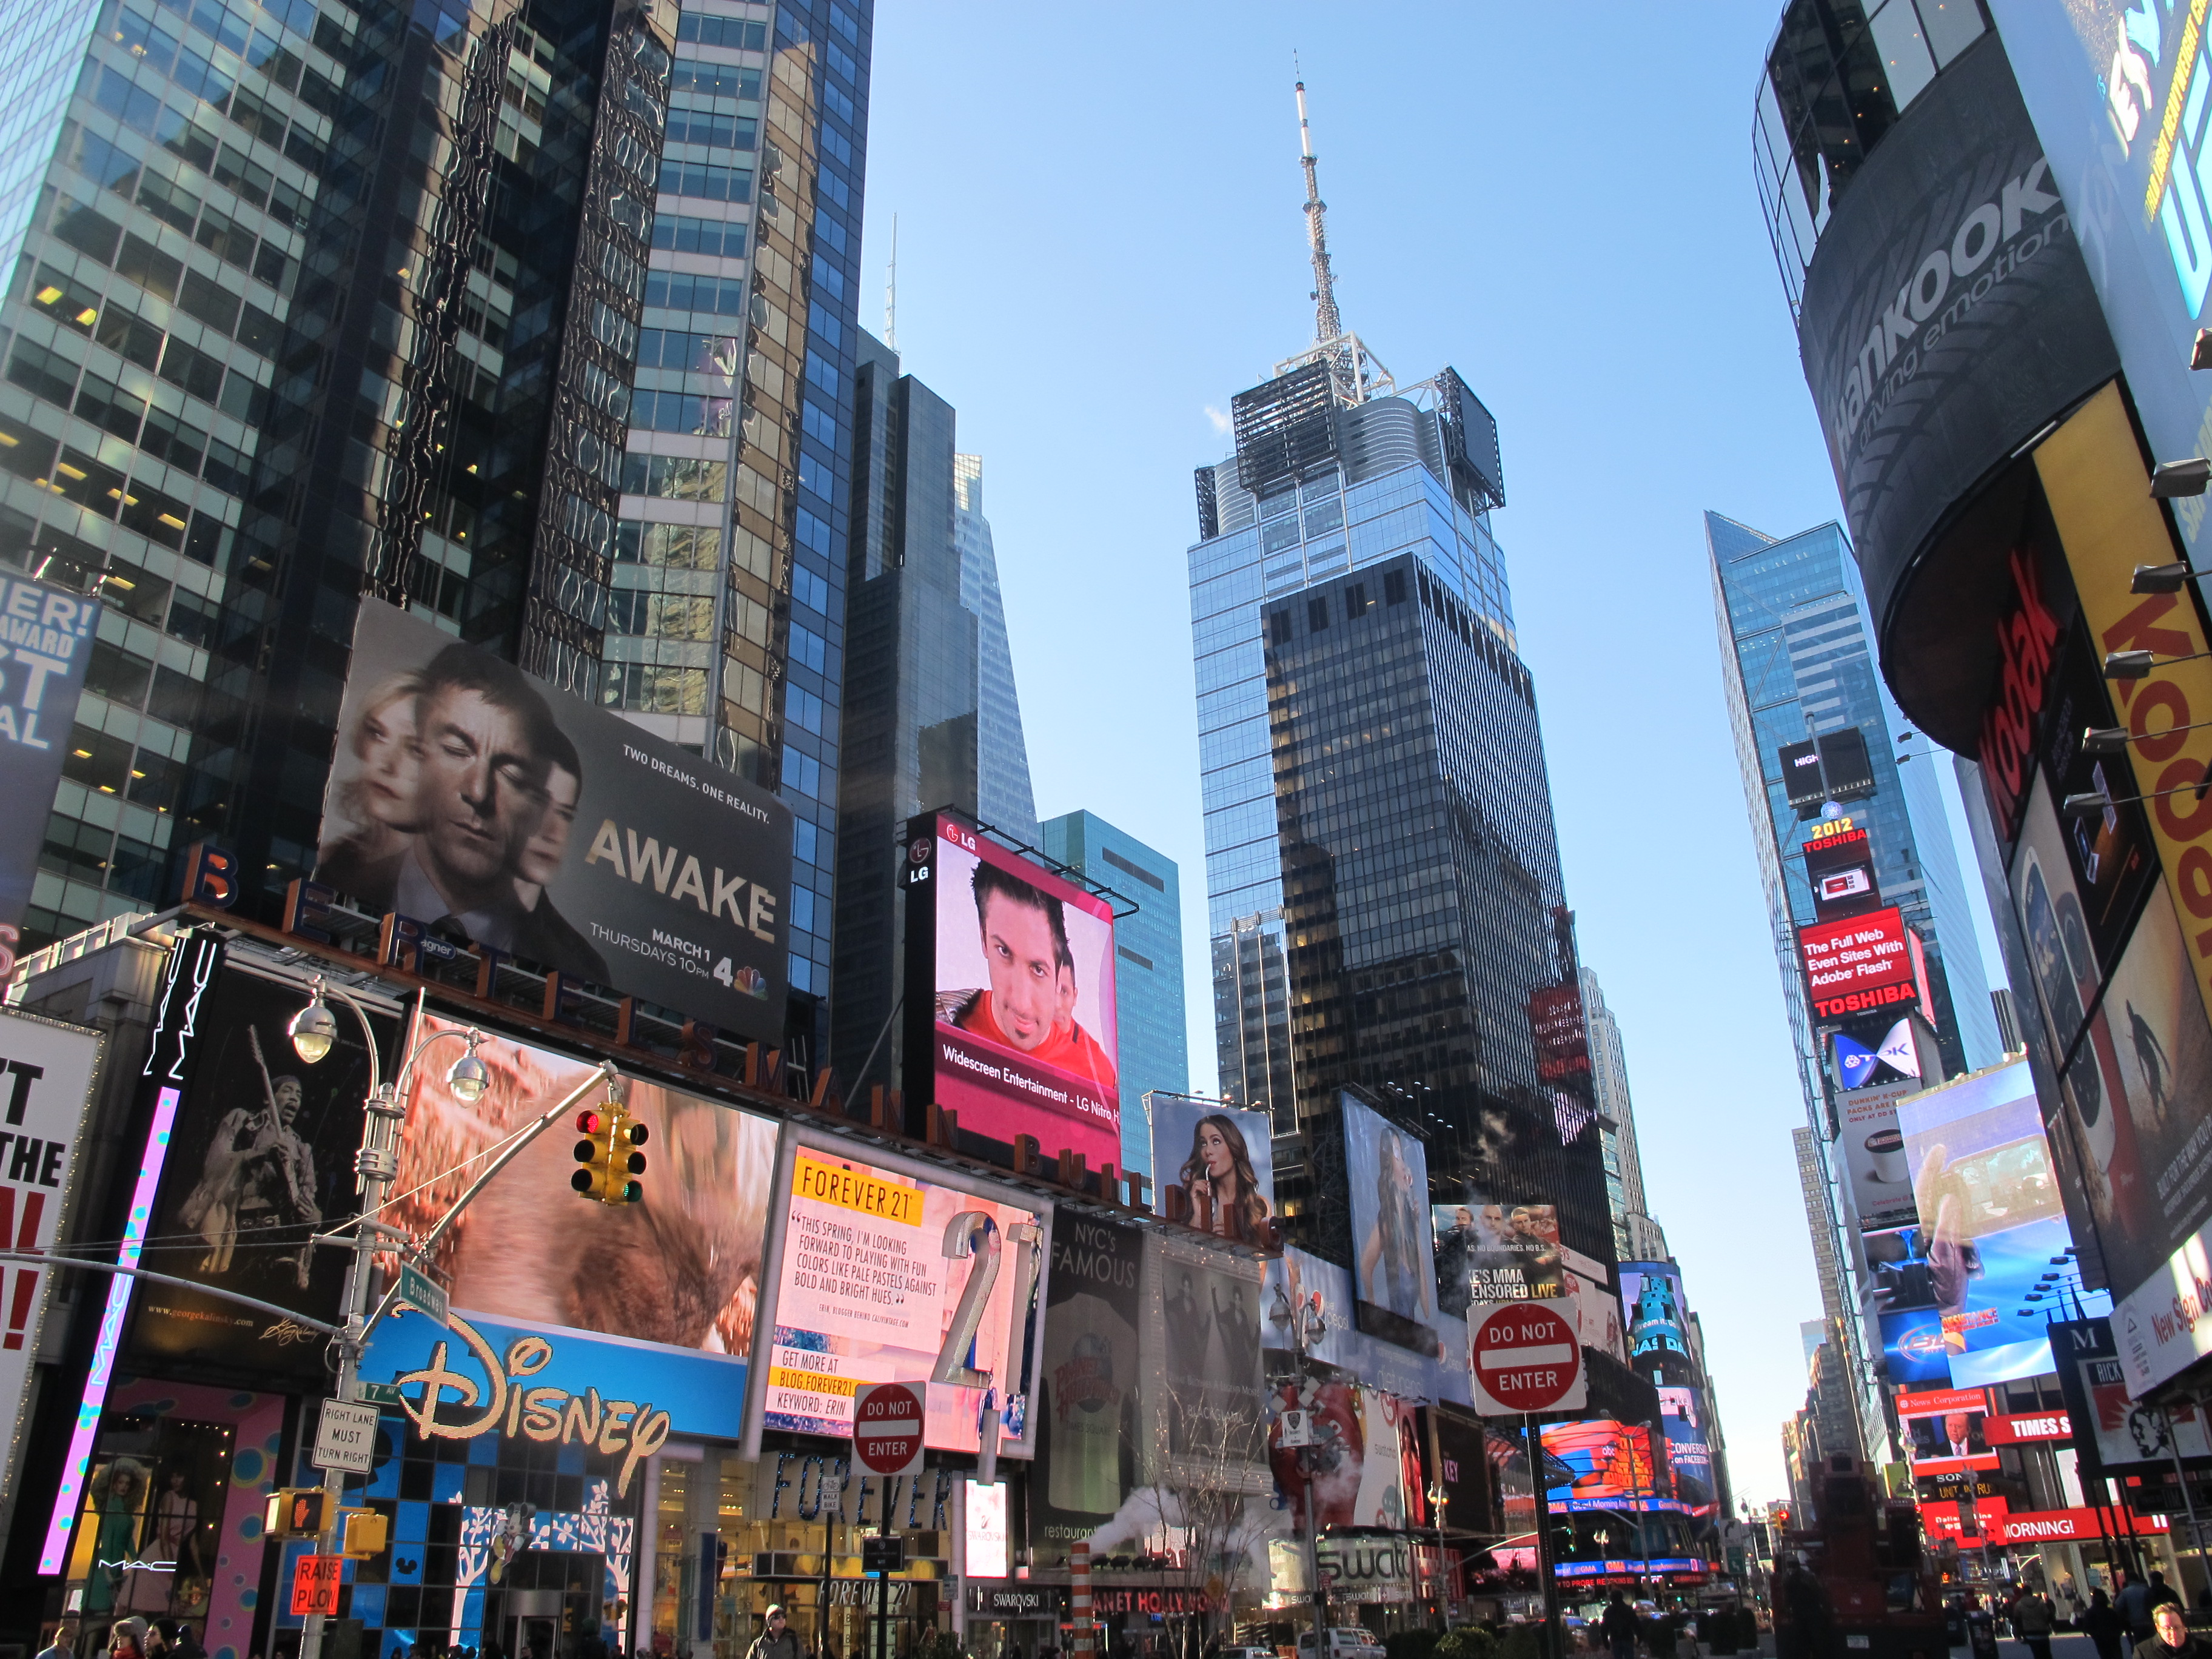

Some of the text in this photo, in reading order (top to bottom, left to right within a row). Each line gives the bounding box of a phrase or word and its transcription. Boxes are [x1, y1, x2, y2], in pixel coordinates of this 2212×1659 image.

[2145, 13, 2200, 223] ORLD LIGHT HEAVYWEIGHT
[1859, 213, 2070, 453] driving emotion
[0, 578, 93, 637] ER!
[623, 743, 770, 825] TWO DREAMS. ONE REALITY.
[1811, 817, 1854, 840] 2012
[960, 831, 976, 852] LG
[1803, 828, 1867, 853] TOSHIBA
[585, 819, 776, 945] AWAKE
[911, 866, 929, 883] LG
[421, 939, 452, 956] agner
[589, 922, 710, 979] THURSDAYS 10PM
[652, 928, 711, 962] MARCH 1
[1805, 928, 1885, 957] The Full Web
[1808, 940, 1903, 971] Even Sites With
[713, 956, 734, 988] 4
[1815, 982, 1917, 1017] TOSHIBA
[0, 1058, 44, 1126] T
[943, 1044, 1000, 1081] Widescreen
[1003, 1067, 1068, 1114] Entertainment
[1076, 1091, 1090, 1111] LG
[1091, 1099, 1112, 1122] Nitro
[1113, 1110, 1121, 1125] H
[1847, 1104, 1872, 1115] PACKS
[1848, 1094, 1880, 1106] DUNKIN'
[1883, 1090, 1908, 1099] K-CUP
[802, 1165, 910, 1220] FOREVER 21
[822, 1221, 854, 1245] SPRING,
[857, 1230, 870, 1245] I'M
[872, 1233, 907, 1255] LOOKING
[1075, 1222, 1116, 1252] NYC's
[799, 1234, 927, 1278] FORWARD TO PLAYING WITH FUN
[1051, 1241, 1135, 1290] FAMOUS
[794, 1271, 870, 1301] BOLD AND BRIGHT
[797, 1252, 937, 1298] COLORS LIKE PALE PASTELS AGAINST
[1493, 1269, 1525, 1284] MMA
[409, 1276, 444, 1319] Broadway
[1472, 1283, 1558, 1299] ENSORED LIVE
[149, 1305, 253, 1327] www.georgekalinsky.com
[819, 1304, 831, 1315] ERIN,
[833, 1306, 853, 1317] BLOGGER
[854, 1310, 871, 1321] BEHIND
[1326, 1311, 1349, 1331] pepsi
[2151, 1311, 2176, 1347] New
[2172, 1293, 2200, 1333] Sign
[1489, 1322, 1556, 1344] DO NOT
[2071, 1327, 2098, 1350] M
[782, 1350, 839, 1374] GET MORE AT
[780, 1371, 860, 1397] BLOG.FOREVER21.
[1499, 1370, 1558, 1391] ENTER
[370, 1386, 396, 1399] 7 AV
[777, 1392, 847, 1416] KEYWORD: ERIN
[1911, 1393, 1982, 1407] News Corporation
[325, 1408, 374, 1426] RIGHT LANE
[867, 1401, 912, 1416] DO NOT
[331, 1428, 361, 1444] MUST
[2011, 1418, 2059, 1438] TIMES
[318, 1447, 369, 1464] TURN RIGHT
[868, 1441, 907, 1456] ENTER
[1444, 1458, 1458, 1483] KEY
[968, 1530, 1006, 1543] SWAROVSKI
[2003, 1520, 2075, 1538] MORNING!
[300, 1563, 338, 1583] RAISE
[297, 1589, 335, 1610] PLOW
[993, 1594, 1039, 1607] SWAROVSKI
[1093, 1591, 1132, 1612] ANET
